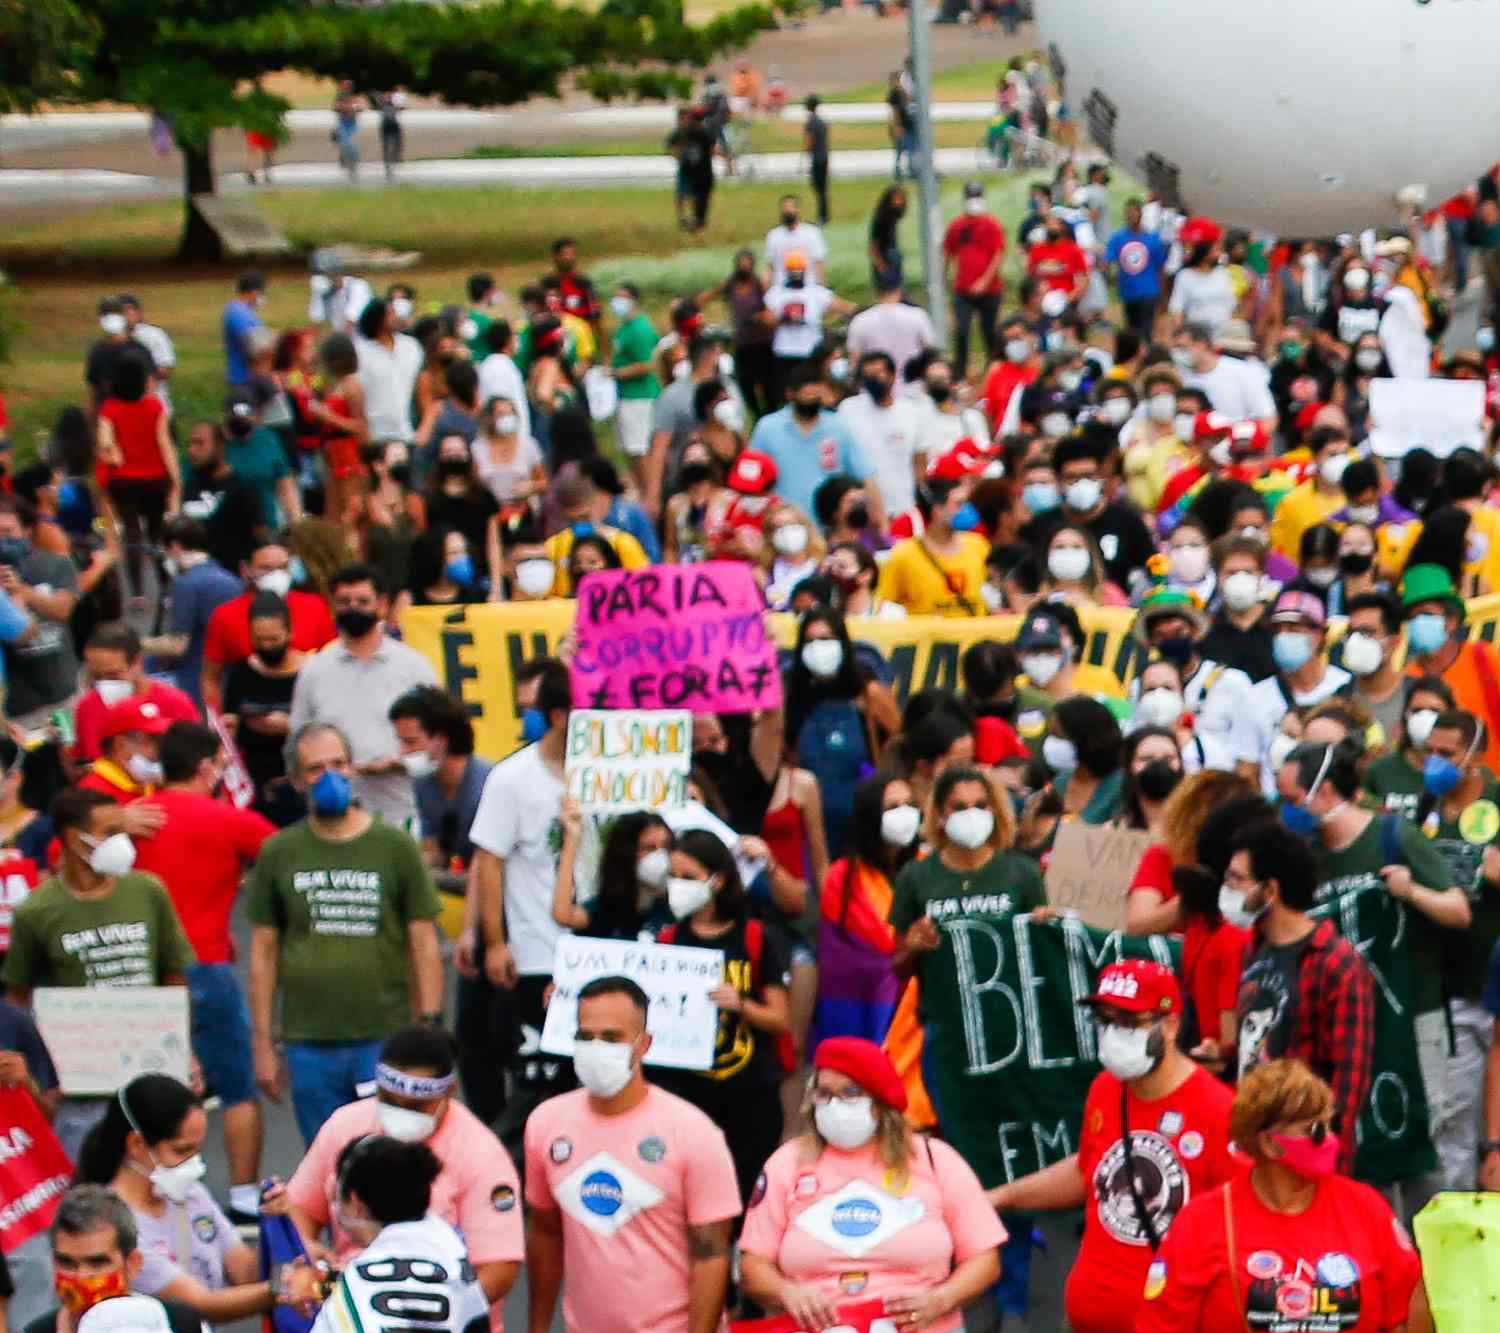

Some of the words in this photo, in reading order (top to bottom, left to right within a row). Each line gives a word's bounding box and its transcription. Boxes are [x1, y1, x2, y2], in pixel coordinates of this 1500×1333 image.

[588, 567, 727, 623] PÁRIA
[442, 607, 484, 718] É
[574, 615, 764, 675] CORRUPTO
[630, 660, 744, 706] FORA
